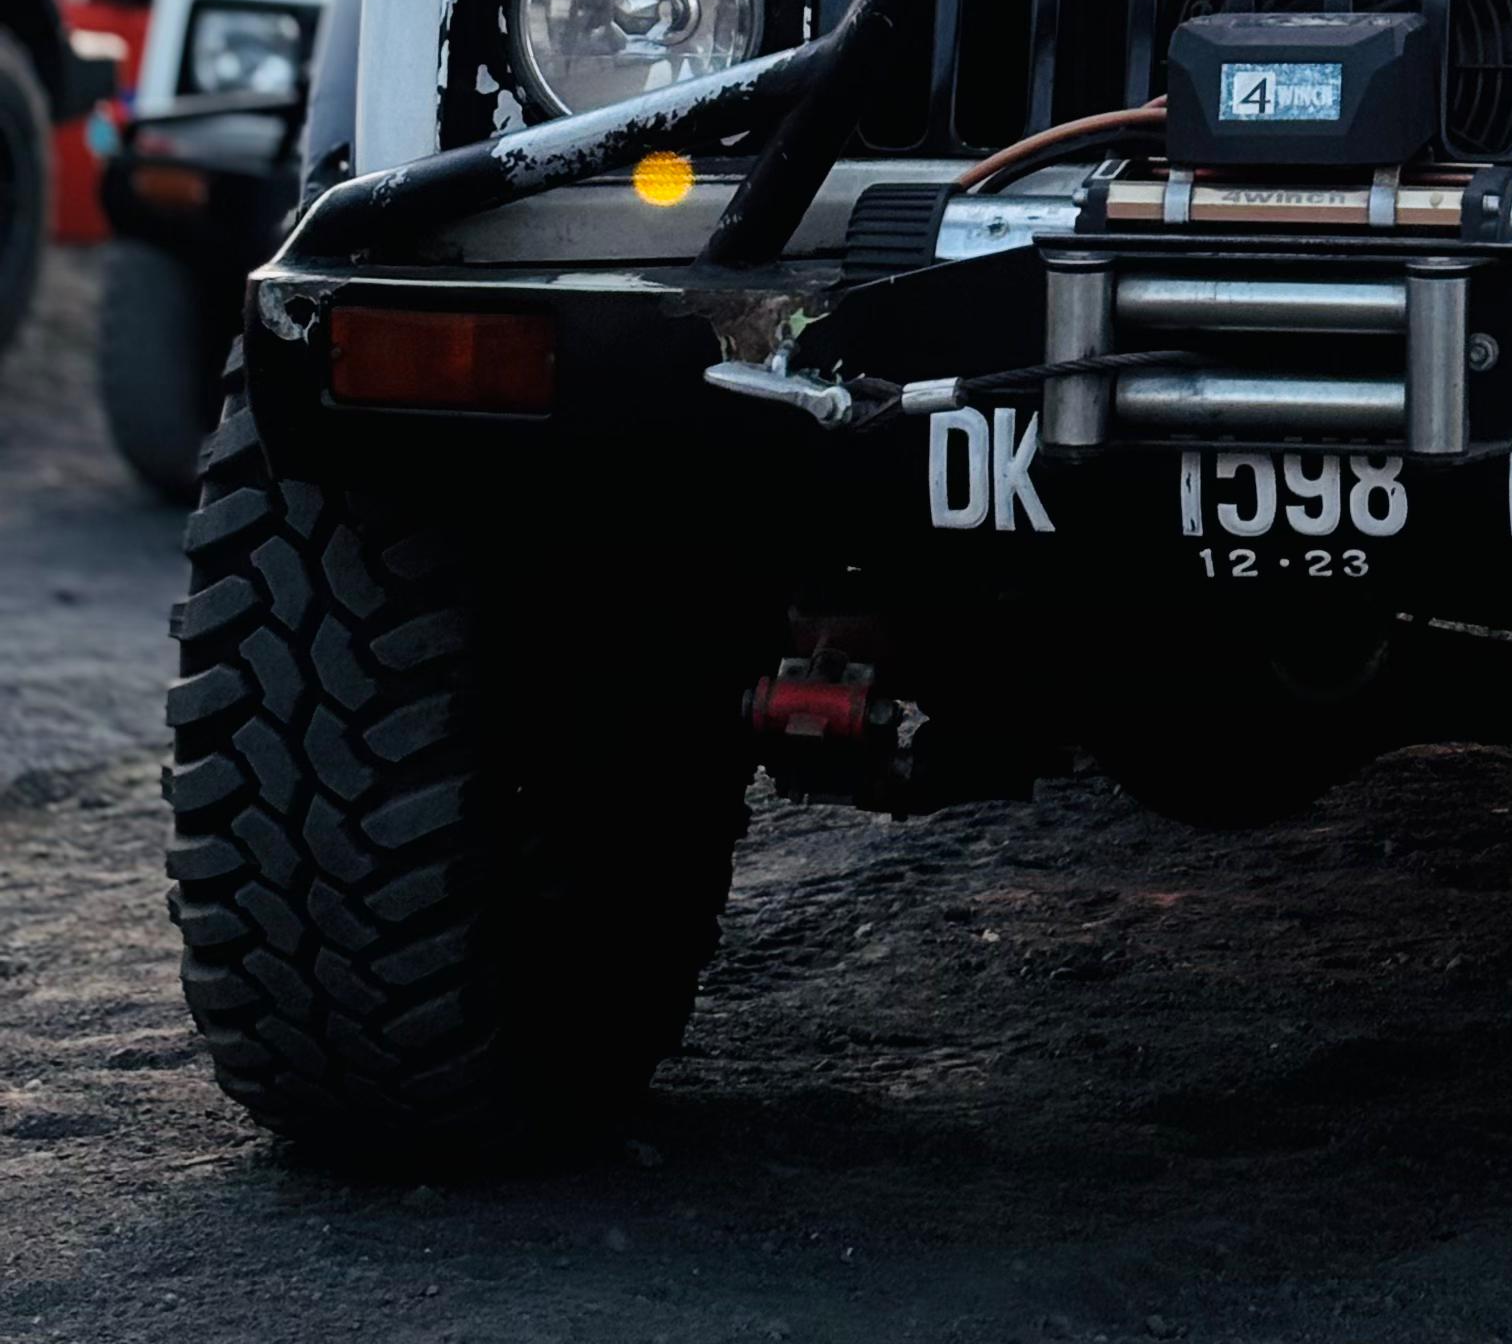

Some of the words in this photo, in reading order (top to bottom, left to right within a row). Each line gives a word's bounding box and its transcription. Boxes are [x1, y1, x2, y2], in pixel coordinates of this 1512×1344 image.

[1240, 77, 1271, 114] 4
[928, 406, 1057, 532] DK
[1180, 451, 1409, 537] 1598
